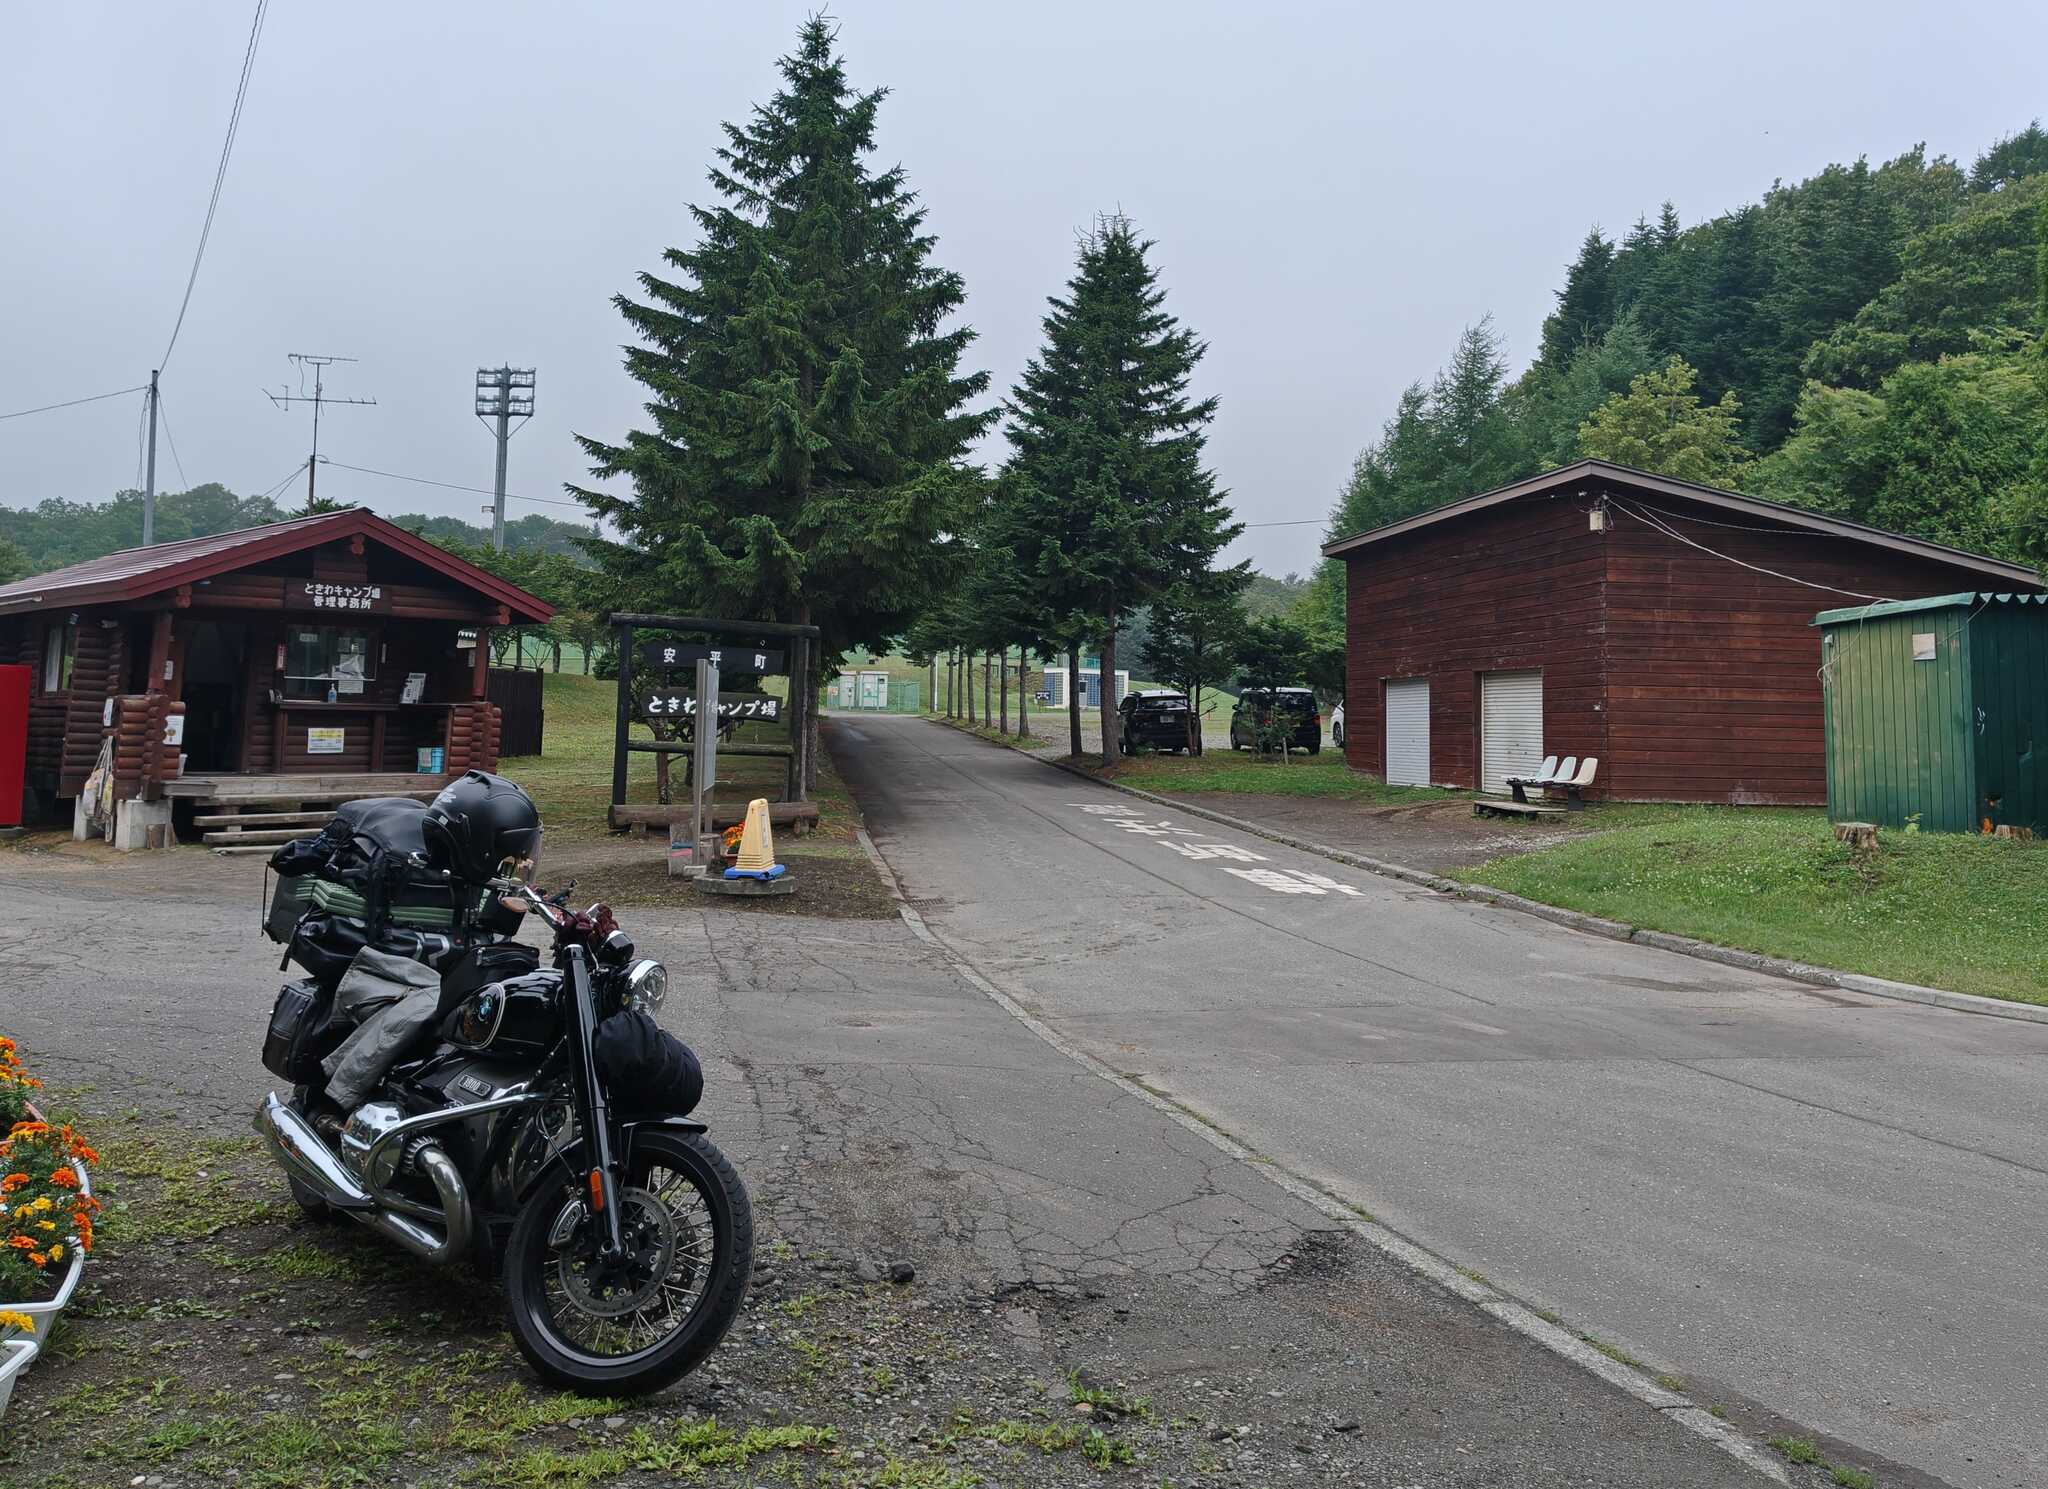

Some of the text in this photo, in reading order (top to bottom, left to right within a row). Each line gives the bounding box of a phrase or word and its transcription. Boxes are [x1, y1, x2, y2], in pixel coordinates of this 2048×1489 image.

[305, 583, 381, 599] ときわキャンプ場
[313, 595, 372, 609] 管理事務所
[663, 648, 767, 669] 安平町
[648, 696, 777, 717] ときわャンプ場
